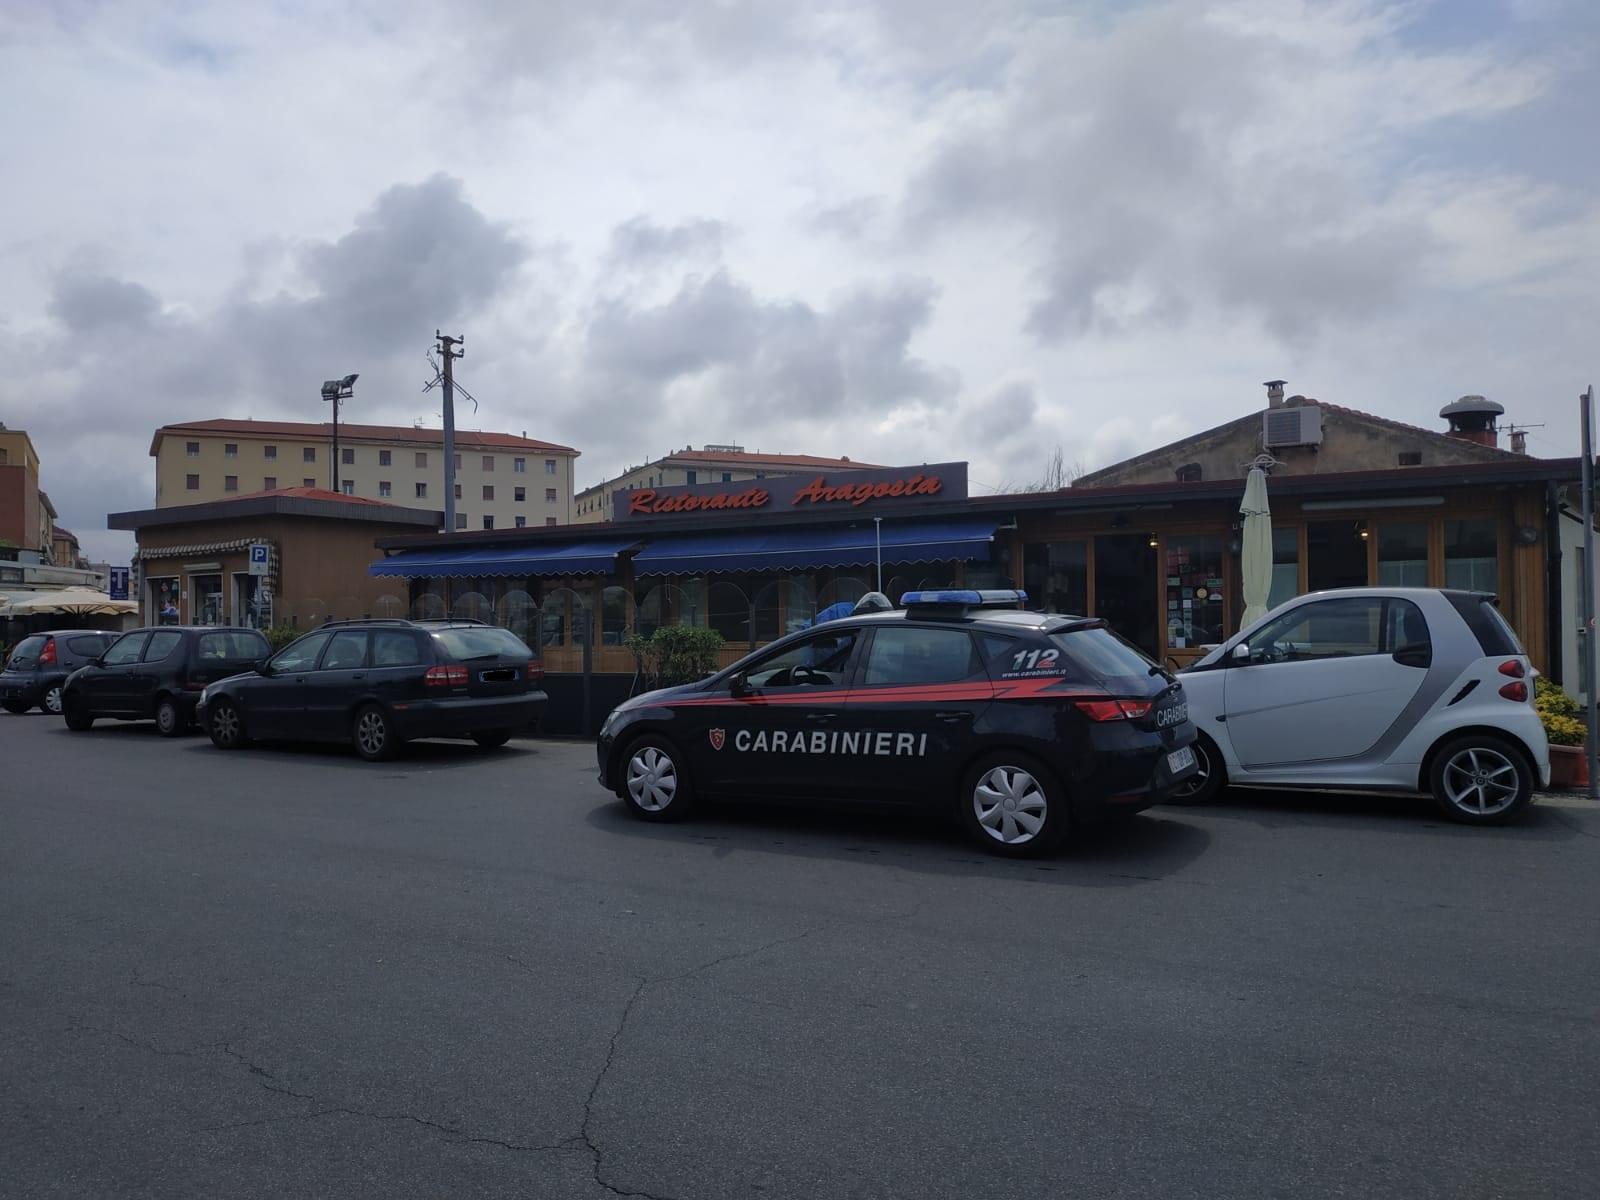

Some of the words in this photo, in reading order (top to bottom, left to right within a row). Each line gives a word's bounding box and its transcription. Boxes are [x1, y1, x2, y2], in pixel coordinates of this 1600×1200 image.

[629, 489, 768, 515] Ristorante
[792, 475, 940, 505] Aragosta
[255, 548, 264, 560] P
[1012, 648, 1060, 671] 112
[1002, 668, 1067, 678] www.carabinieri.it
[735, 730, 927, 757] CARABINIERI
